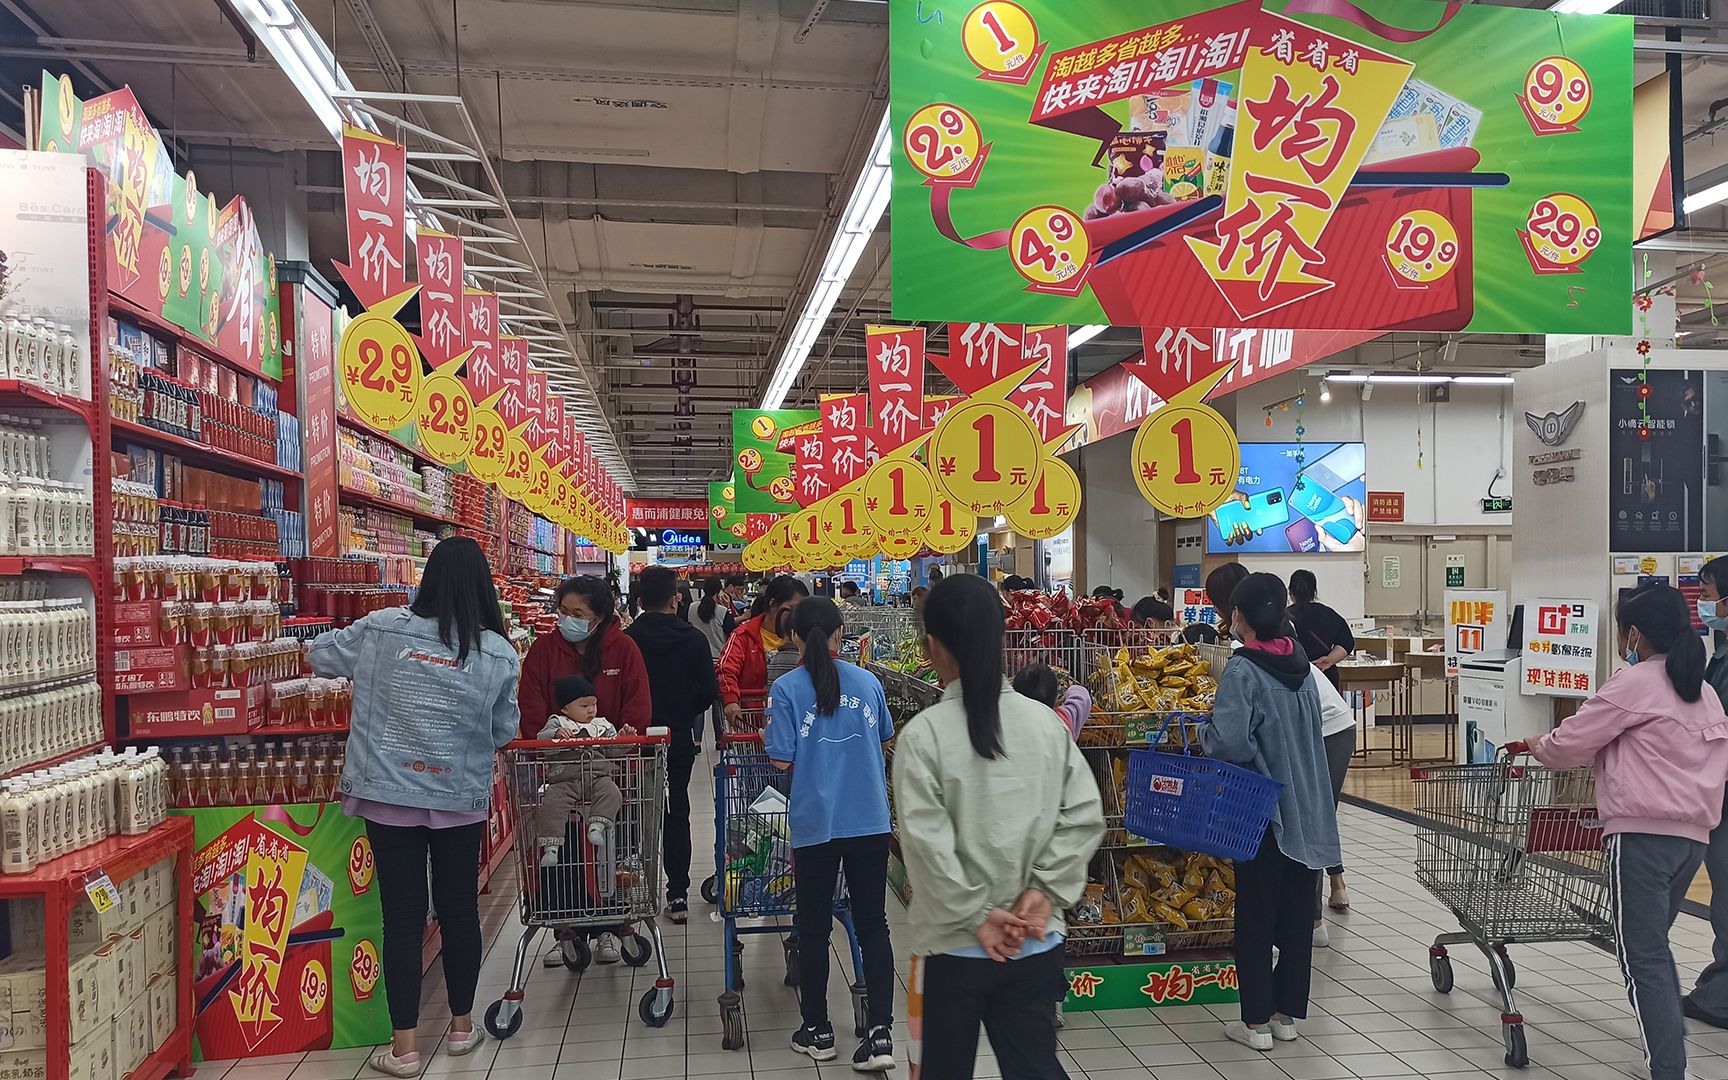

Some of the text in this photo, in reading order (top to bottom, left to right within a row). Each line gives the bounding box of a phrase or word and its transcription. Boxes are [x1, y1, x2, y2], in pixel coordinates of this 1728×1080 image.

[982, 11, 1017, 54] 1
[1262, 27, 1360, 76] 省省省
[1005, 53, 1026, 71] 元/件
[1530, 64, 1587, 113] 9.9
[1538, 107, 1559, 124] 元/件
[950, 156, 971, 174] 元/件
[1214, 75, 1357, 302] 均一价
[353, 143, 402, 297] 均一价
[1529, 199, 1602, 258] 29.9
[1397, 218, 1458, 272] 19.9
[1540, 246, 1562, 264] 元/件
[1055, 263, 1079, 281] 元/件
[1399, 264, 1421, 281] 元/件
[424, 238, 461, 358] 均一价
[311, 327, 328, 361] 特价
[468, 296, 498, 395] 均一价
[960, 323, 1020, 379] 价
[1154, 326, 1211, 384] 价
[501, 340, 526, 425] 均一价
[876, 333, 920, 444] 均一价
[311, 407, 329, 445] 特价
[371, 413, 398, 426] 均一价
[827, 398, 865, 481] 均一价
[800, 433, 829, 501] 均一价
[314, 489, 331, 528] 特价
[970, 500, 1005, 513] 均一价
[1173, 500, 1206, 514] 均一价
[1527, 668, 1590, 691] 现货热销
[146, 709, 201, 723] 东鹏特饮
[238, 867, 289, 1037] 均一价
[1072, 972, 1103, 997] 价
[1141, 966, 1239, 1002] 均一价
